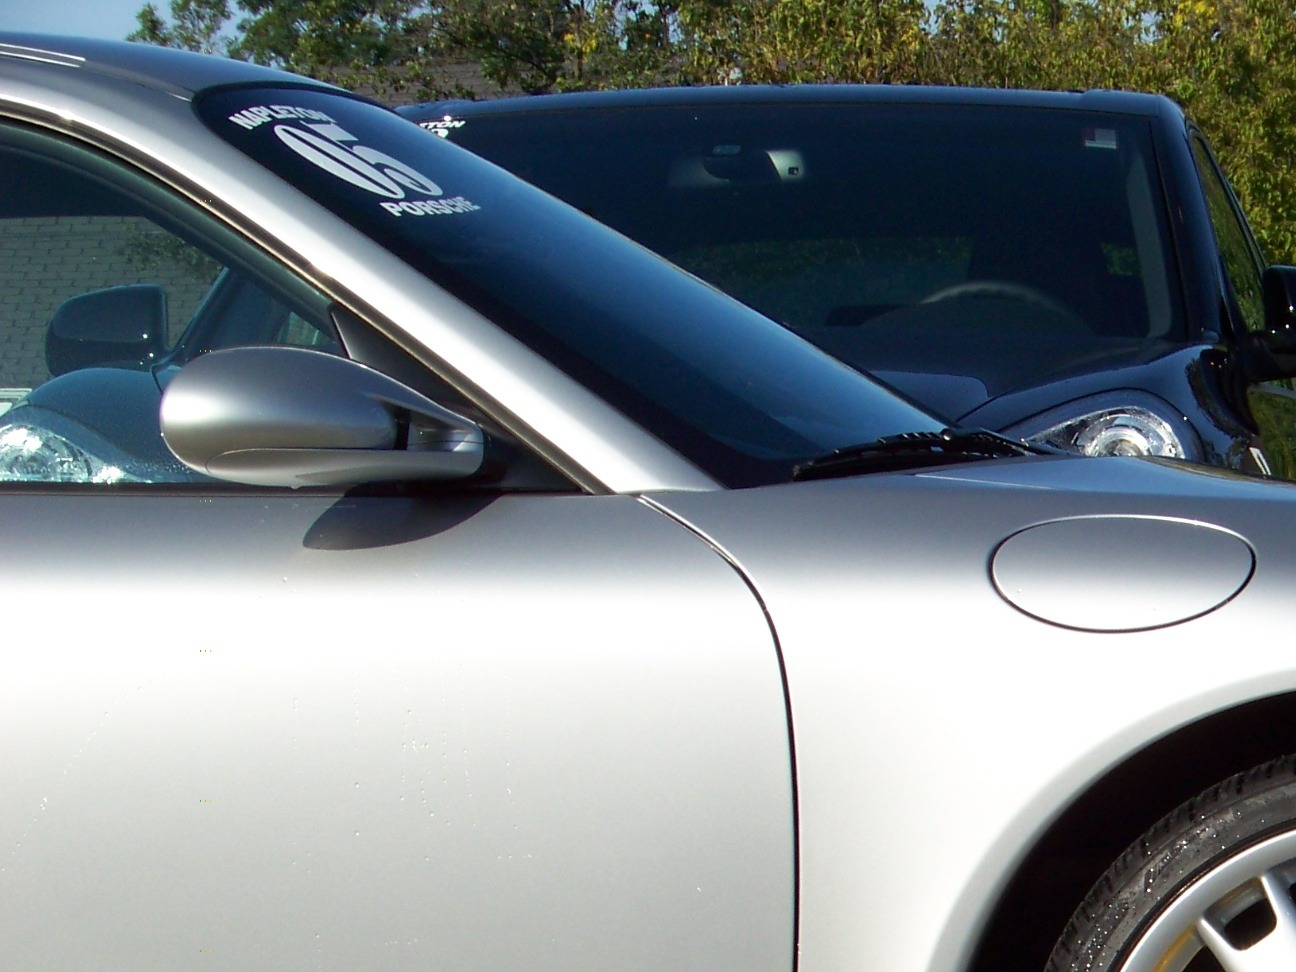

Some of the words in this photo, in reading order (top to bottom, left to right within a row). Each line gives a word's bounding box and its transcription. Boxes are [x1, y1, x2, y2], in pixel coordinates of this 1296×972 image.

[228, 105, 338, 130] NAPLETON
[274, 122, 443, 199] 05
[380, 196, 481, 217] PORSCHE
